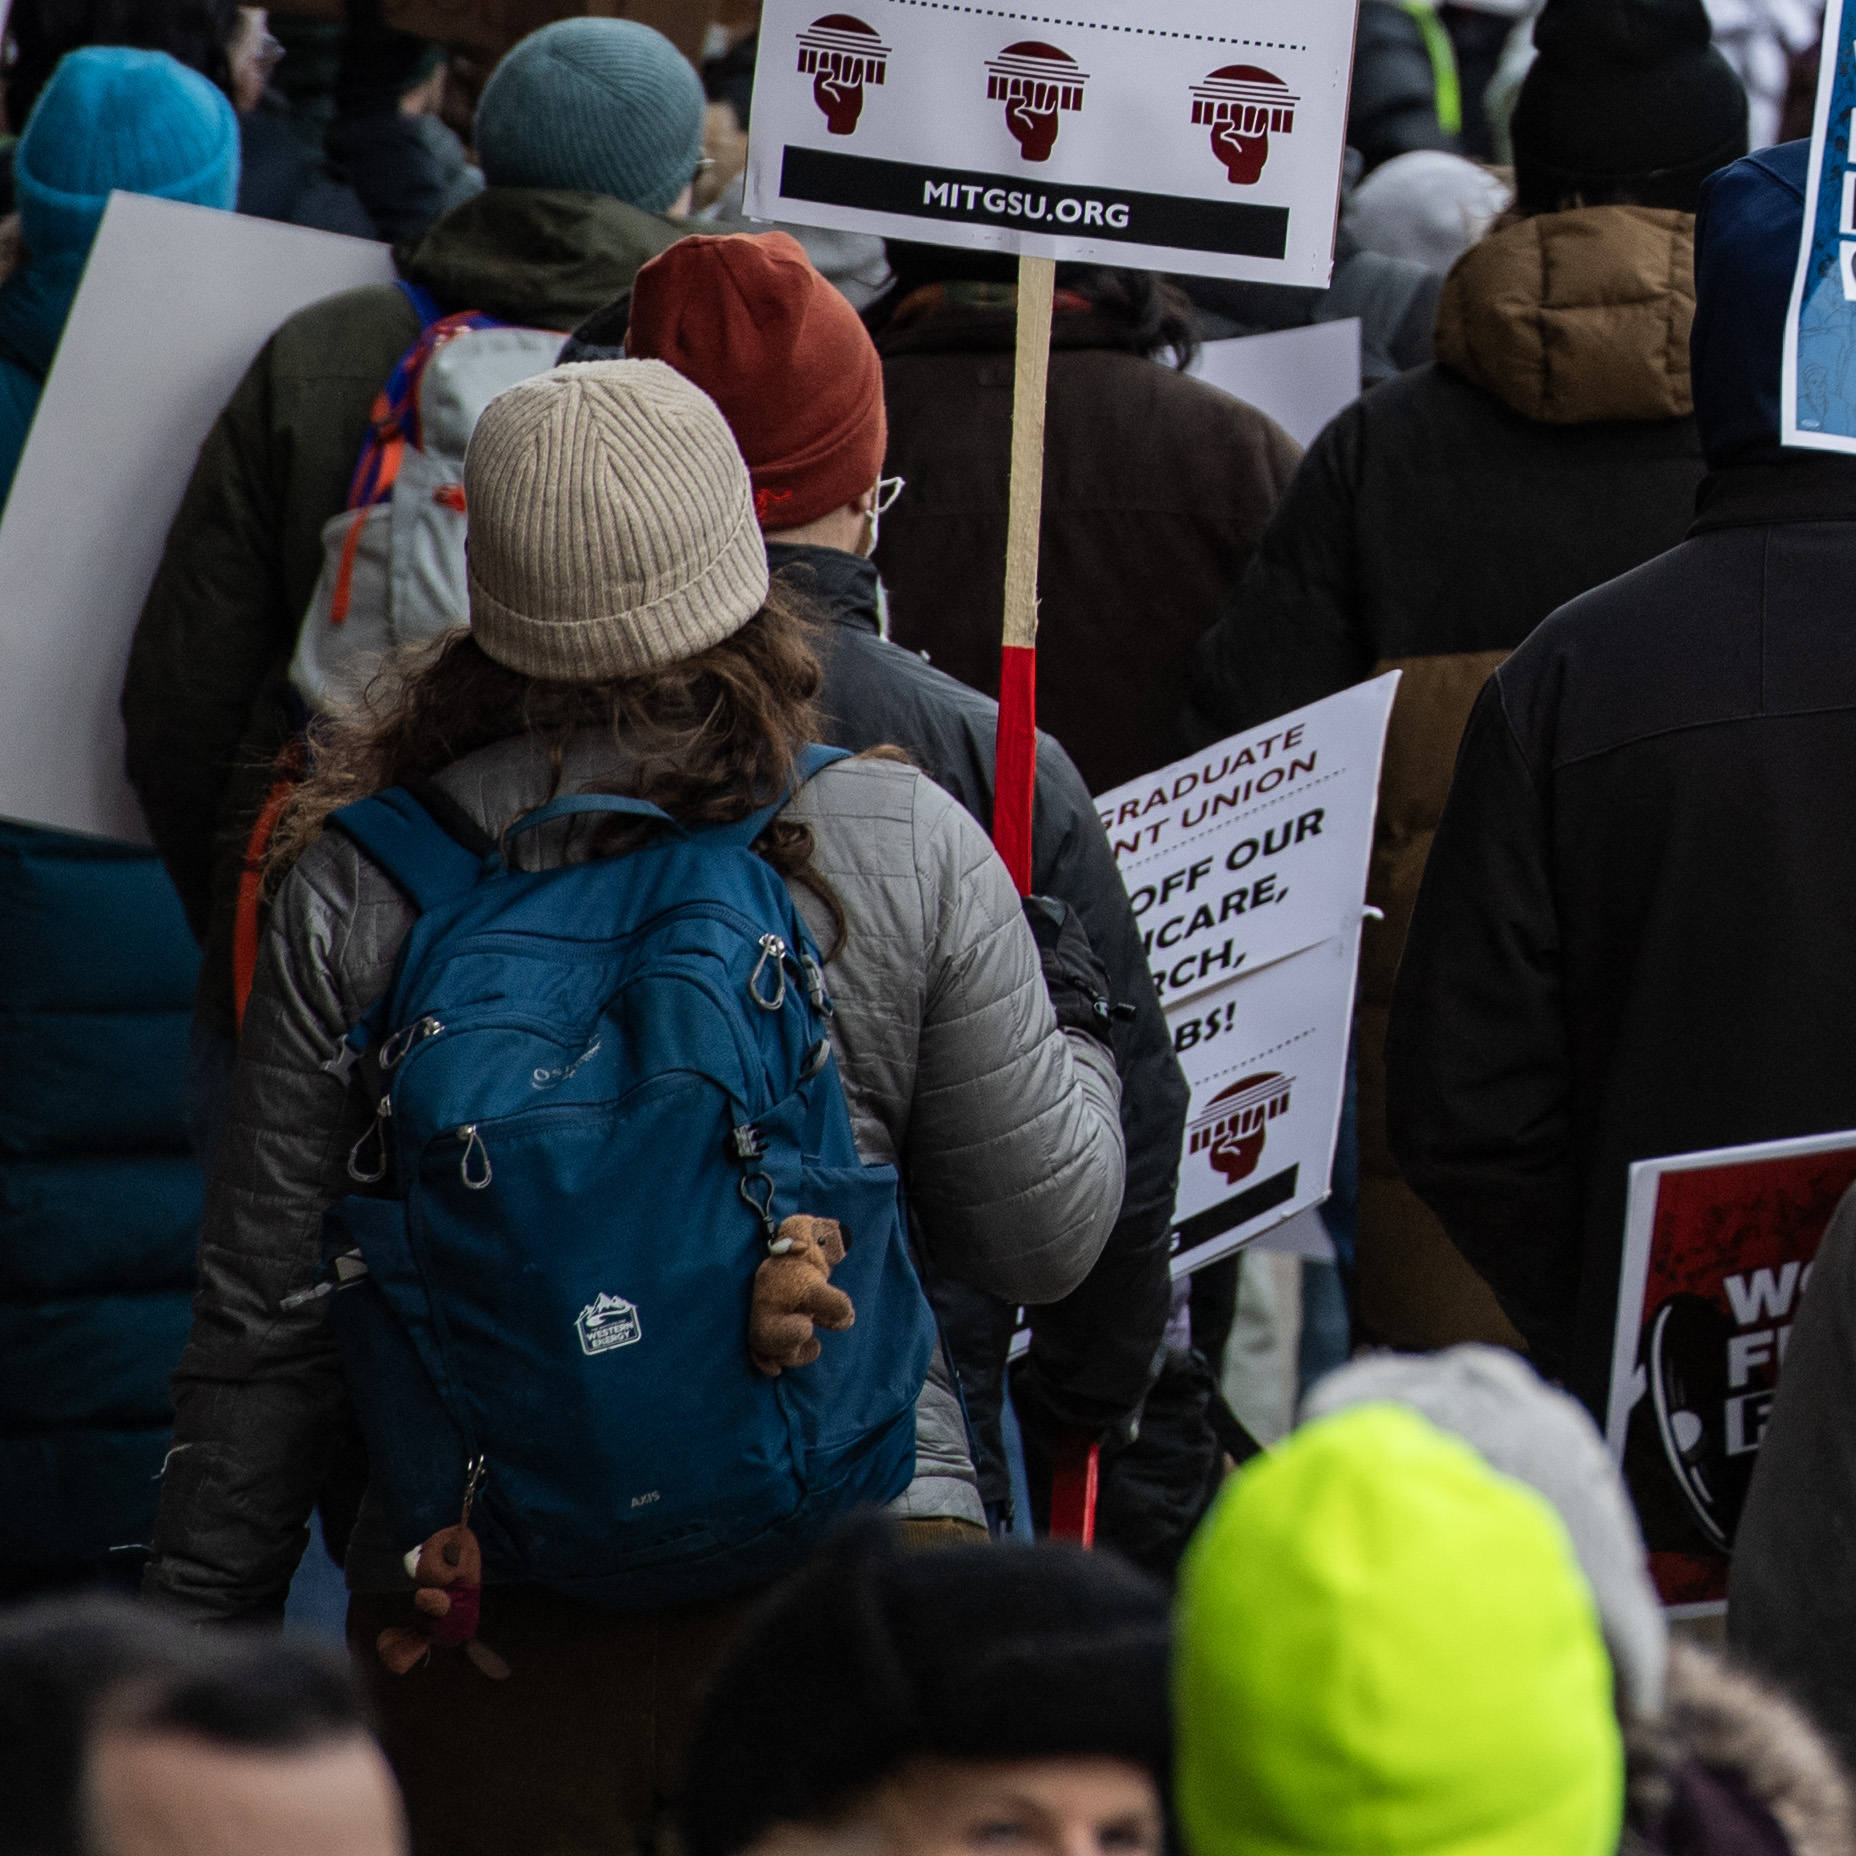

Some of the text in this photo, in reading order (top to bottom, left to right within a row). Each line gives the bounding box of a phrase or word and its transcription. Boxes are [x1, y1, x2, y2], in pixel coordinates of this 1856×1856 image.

[922, 180, 1131, 229] MITGSU.ORG
[1181, 749, 1318, 828] UNION
[1130, 806, 1325, 917] OFF OUR
